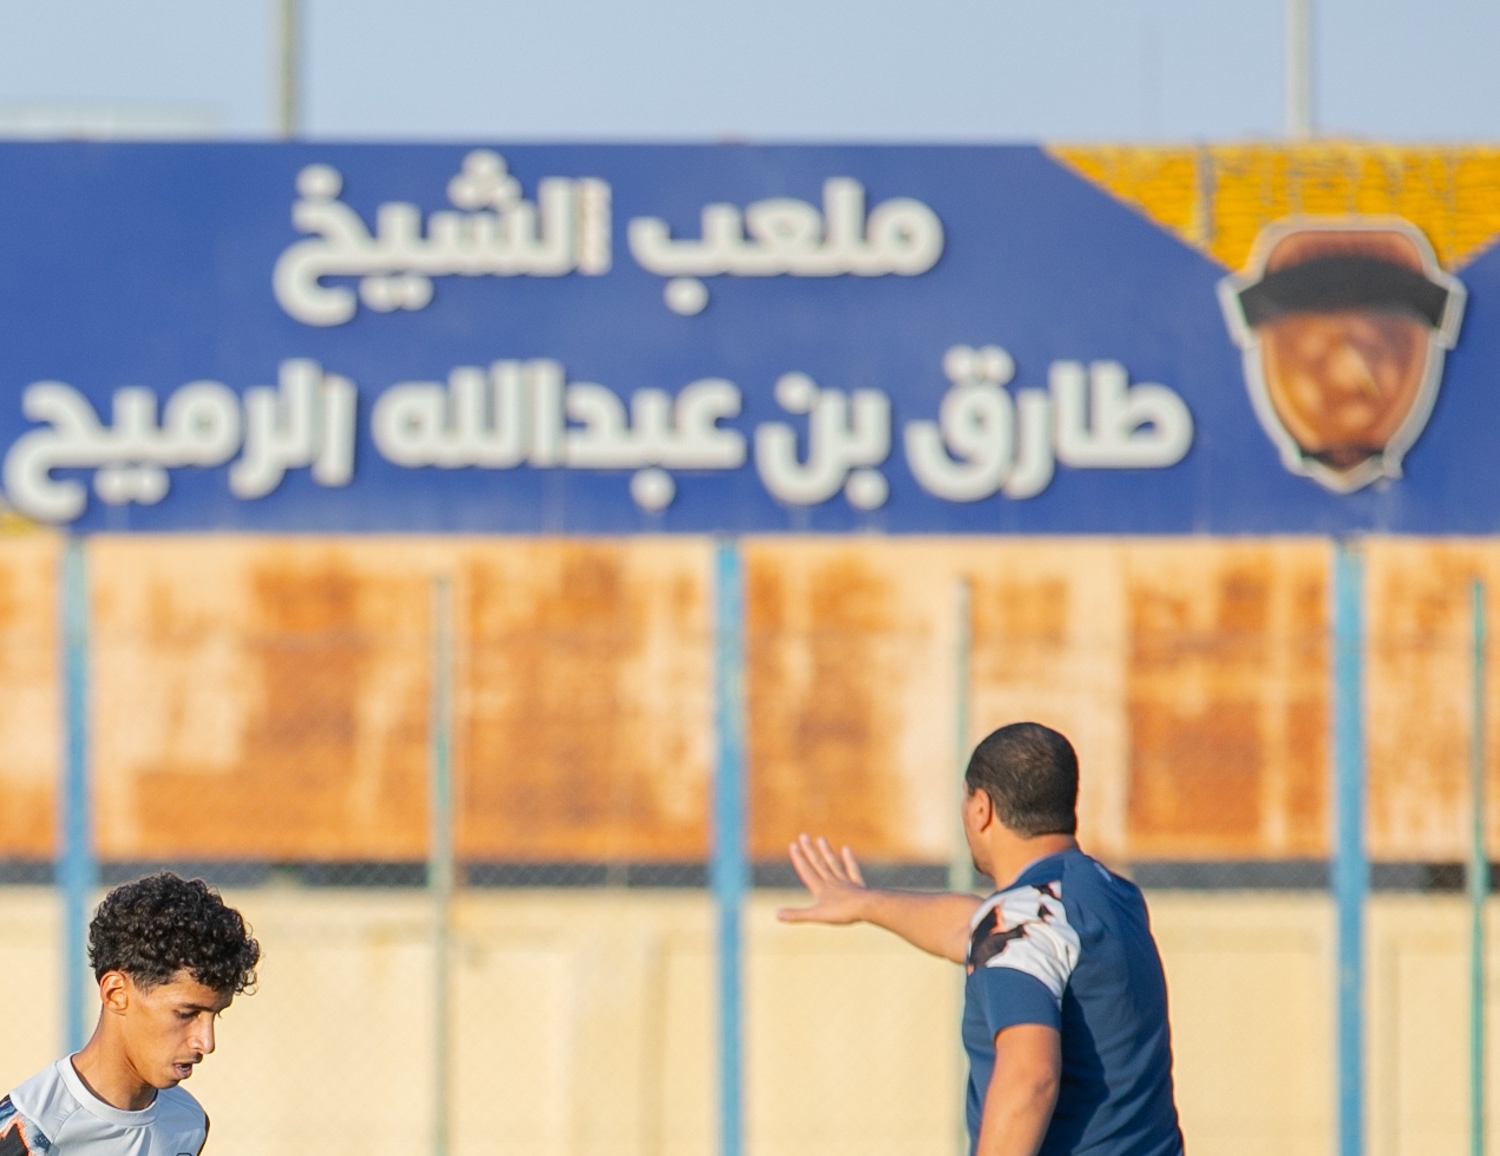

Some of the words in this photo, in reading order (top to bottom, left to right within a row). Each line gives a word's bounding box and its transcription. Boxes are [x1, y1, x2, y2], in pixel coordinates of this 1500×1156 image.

[272, 150, 613, 327] الشيخ
[627, 176, 944, 316] ملعب
[3, 358, 358, 525] الرميح
[370, 358, 747, 514] عبدالله
[754, 372, 891, 511] بن
[903, 345, 1193, 503] طارق
